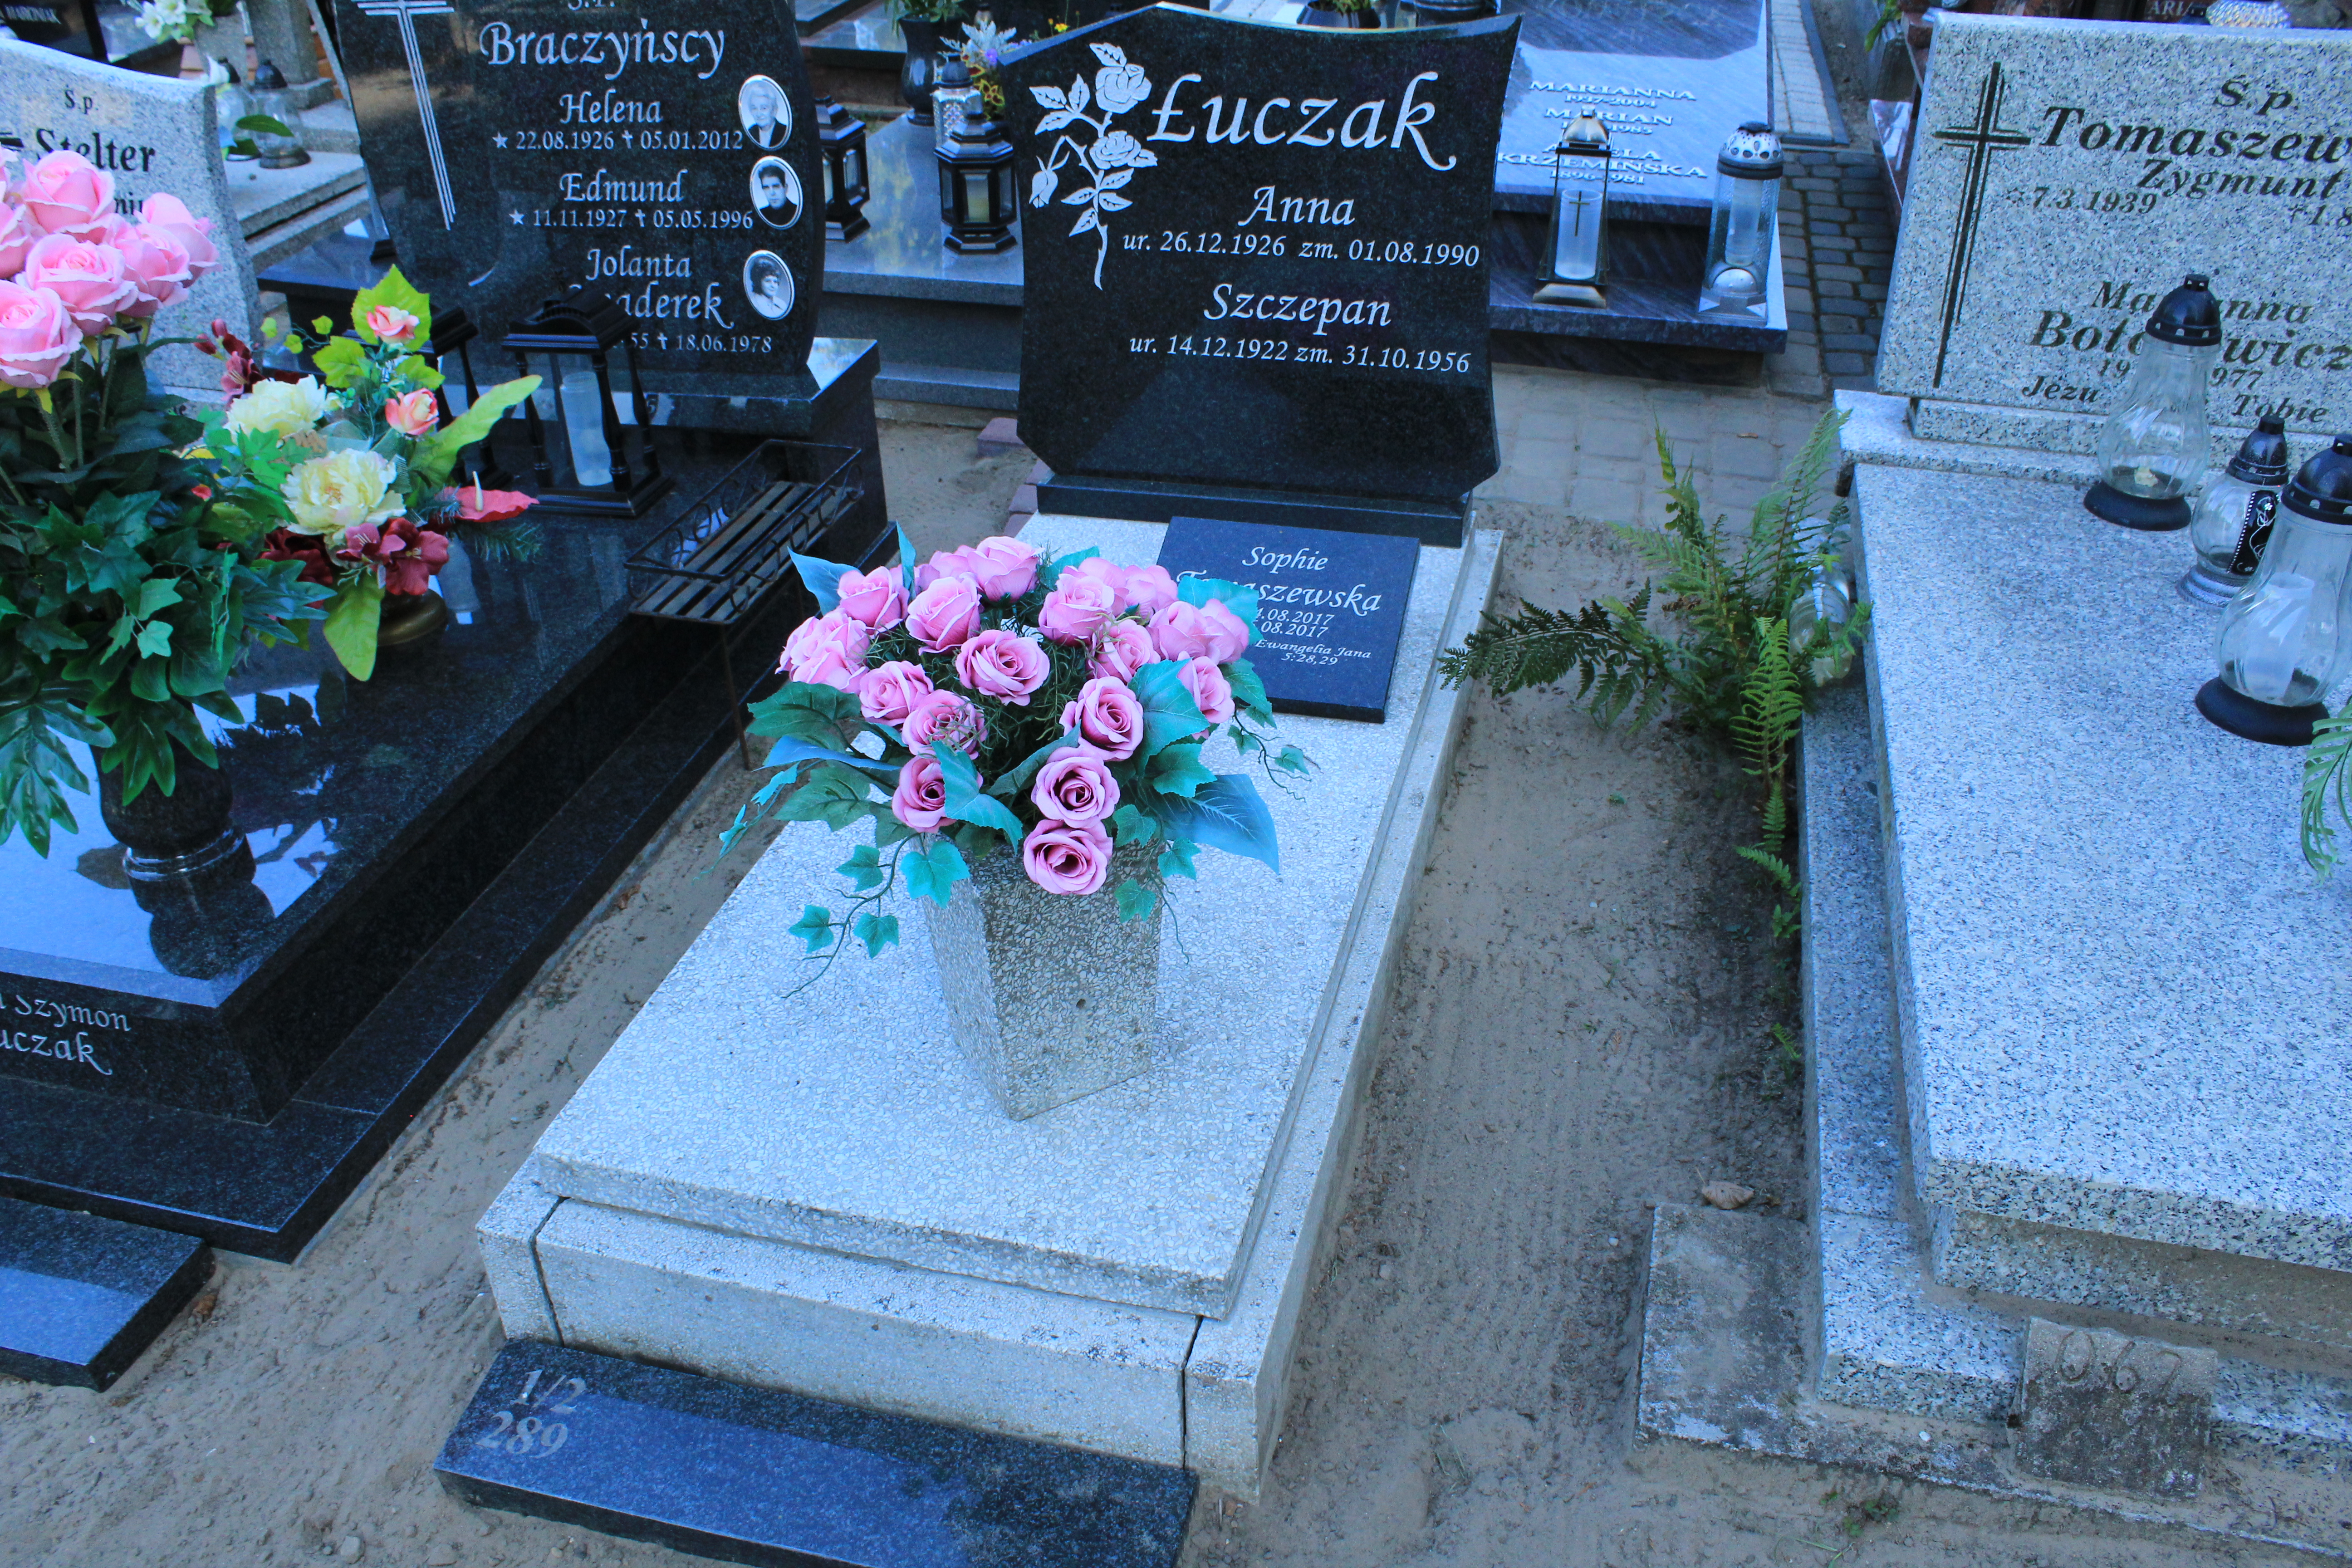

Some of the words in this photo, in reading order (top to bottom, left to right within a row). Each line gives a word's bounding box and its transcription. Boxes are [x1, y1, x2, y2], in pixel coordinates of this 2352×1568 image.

[479, 18, 725, 80] Braczyńscy
[559, 88, 664, 124] Helena
[1529, 80, 1697, 102] MARIANNA
[1146, 71, 1457, 171] Łuczak
[1544, 108, 1673, 126] MRIAN
[35, 128, 156, 172] Stelter
[515, 131, 615, 150] 22.08.1926
[640, 131, 743, 150] 05.01.2012
[559, 169, 688, 203] Edmund
[1549, 170, 1646, 185] 1896-981
[2136, 159, 2348, 200] Zygmunt
[1237, 186, 1357, 227] Anna
[2033, 186, 2158, 214] 7.3.1939
[532, 209, 627, 228] 11.11.1927
[652, 209, 754, 229] 05.05.1996
[585, 245, 693, 280] Jolanta
[1123, 235, 1152, 251] ur.
[1159, 231, 1286, 256] 26.12.1926
[1298, 242, 1339, 260] zm.
[1348, 239, 1480, 268] 01.08.1990
[1203, 283, 1392, 336] Szczepan
[676, 334, 772, 353] 18.06.1978
[1129, 337, 1158, 354] ur.
[1166, 335, 1288, 361] 14.12.1922
[1296, 347, 1333, 365] zm.
[1342, 345, 1473, 373] 31.10.1956
[2022, 375, 2099, 402] Jezu
[2232, 393, 2329, 422] Tobie
[1242, 547, 1328, 573] Sophie
[1176, 569, 1382, 617] szewska
[1254, 607, 1334, 626] 4.08.2017
[1254, 639, 1332, 655] Ewangelia
[1335, 646, 1372, 659] Jana
[1281, 652, 1338, 666] 5:28,29
[14, 995, 132, 1032] Szymon
[510, 1369, 587, 1414] 1/2
[475, 1411, 569, 1459] 289
